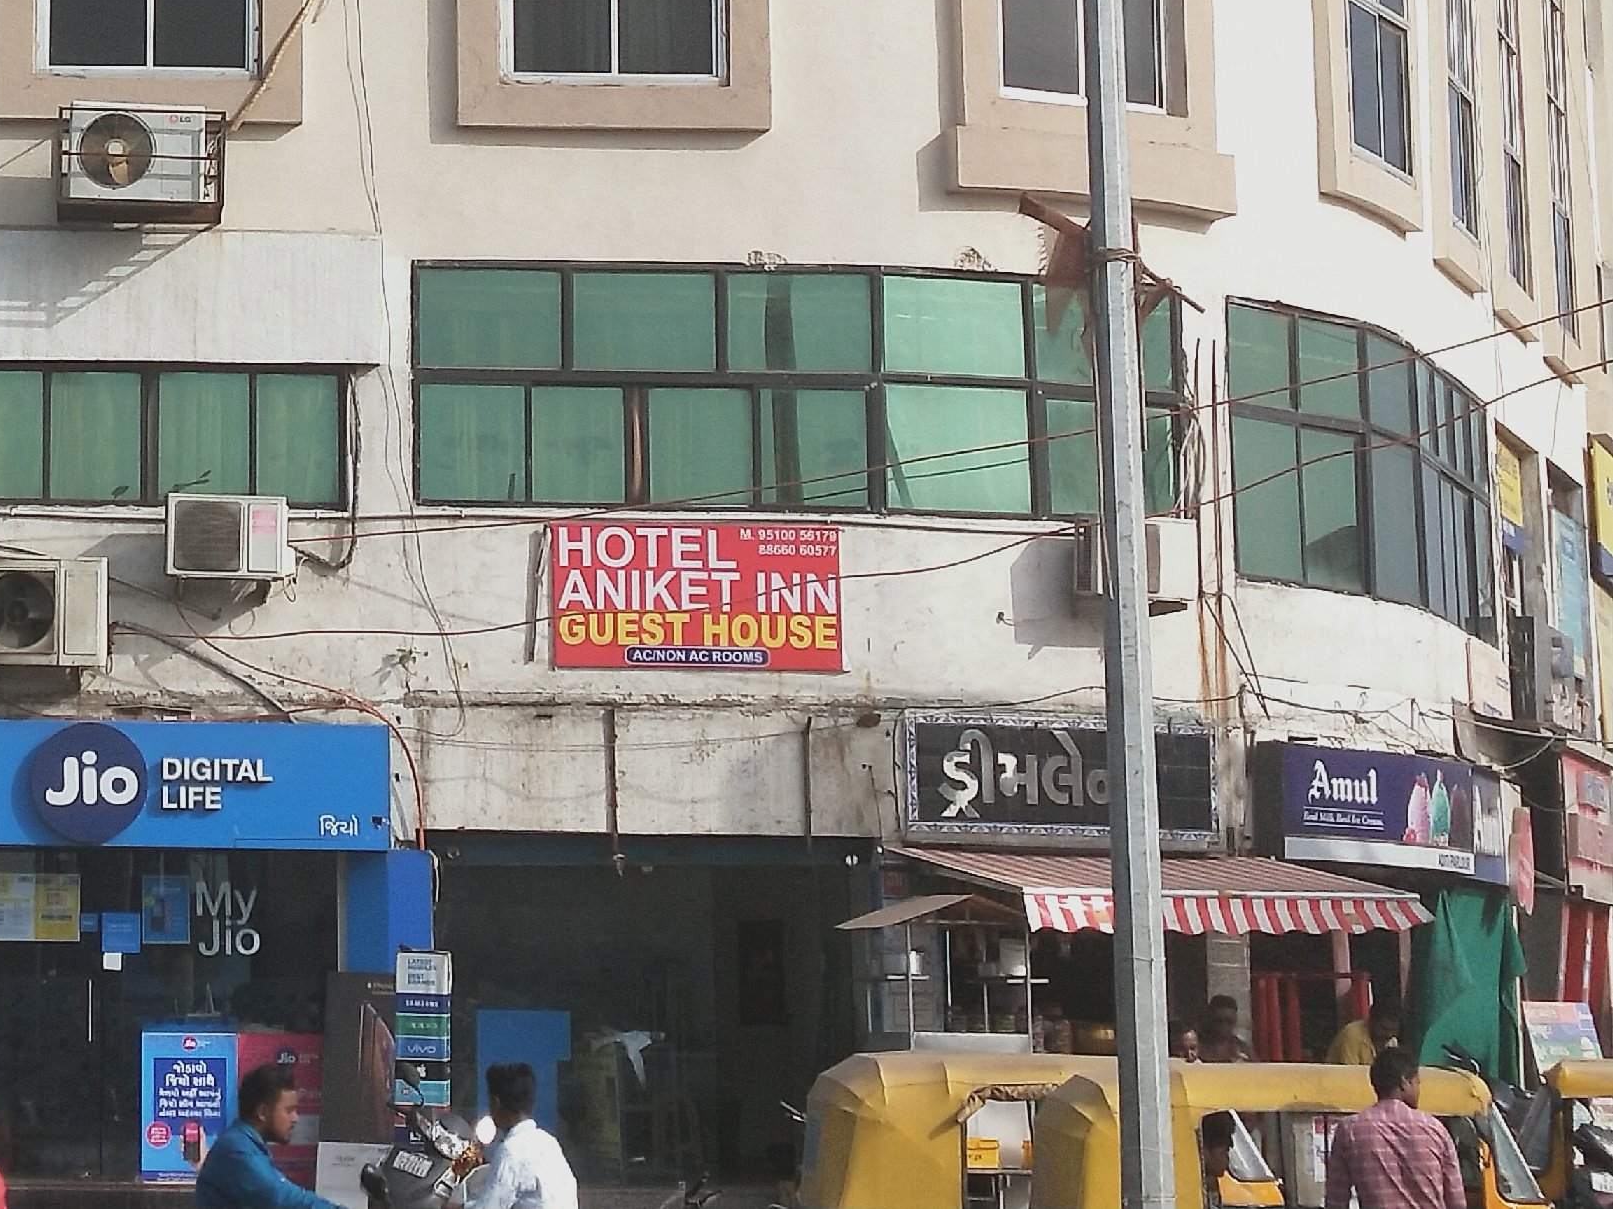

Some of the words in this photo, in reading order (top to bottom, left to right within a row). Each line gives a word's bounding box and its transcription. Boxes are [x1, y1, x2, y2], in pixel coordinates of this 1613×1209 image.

[557, 526, 738, 569] HOTEL
[739, 529, 755, 542] M.
[759, 530, 795, 542] 95100
[557, 569, 740, 613] ANIKET
[756, 573, 837, 615] INN
[559, 612, 690, 646] GUEST
[704, 613, 838, 649] HOUSE
[689, 650, 709, 663] AC
[712, 651, 764, 664] ROOMS
[44, 750, 139, 806] Jio
[161, 757, 274, 783] DIGITAL
[1307, 758, 1379, 805] Amul
[161, 785, 223, 810] LIFE
[318, 814, 360, 838] જિયો
[194, 880, 258, 926] My
[197, 920, 261, 956] Jio
[277, 1052, 297, 1065] Jio
